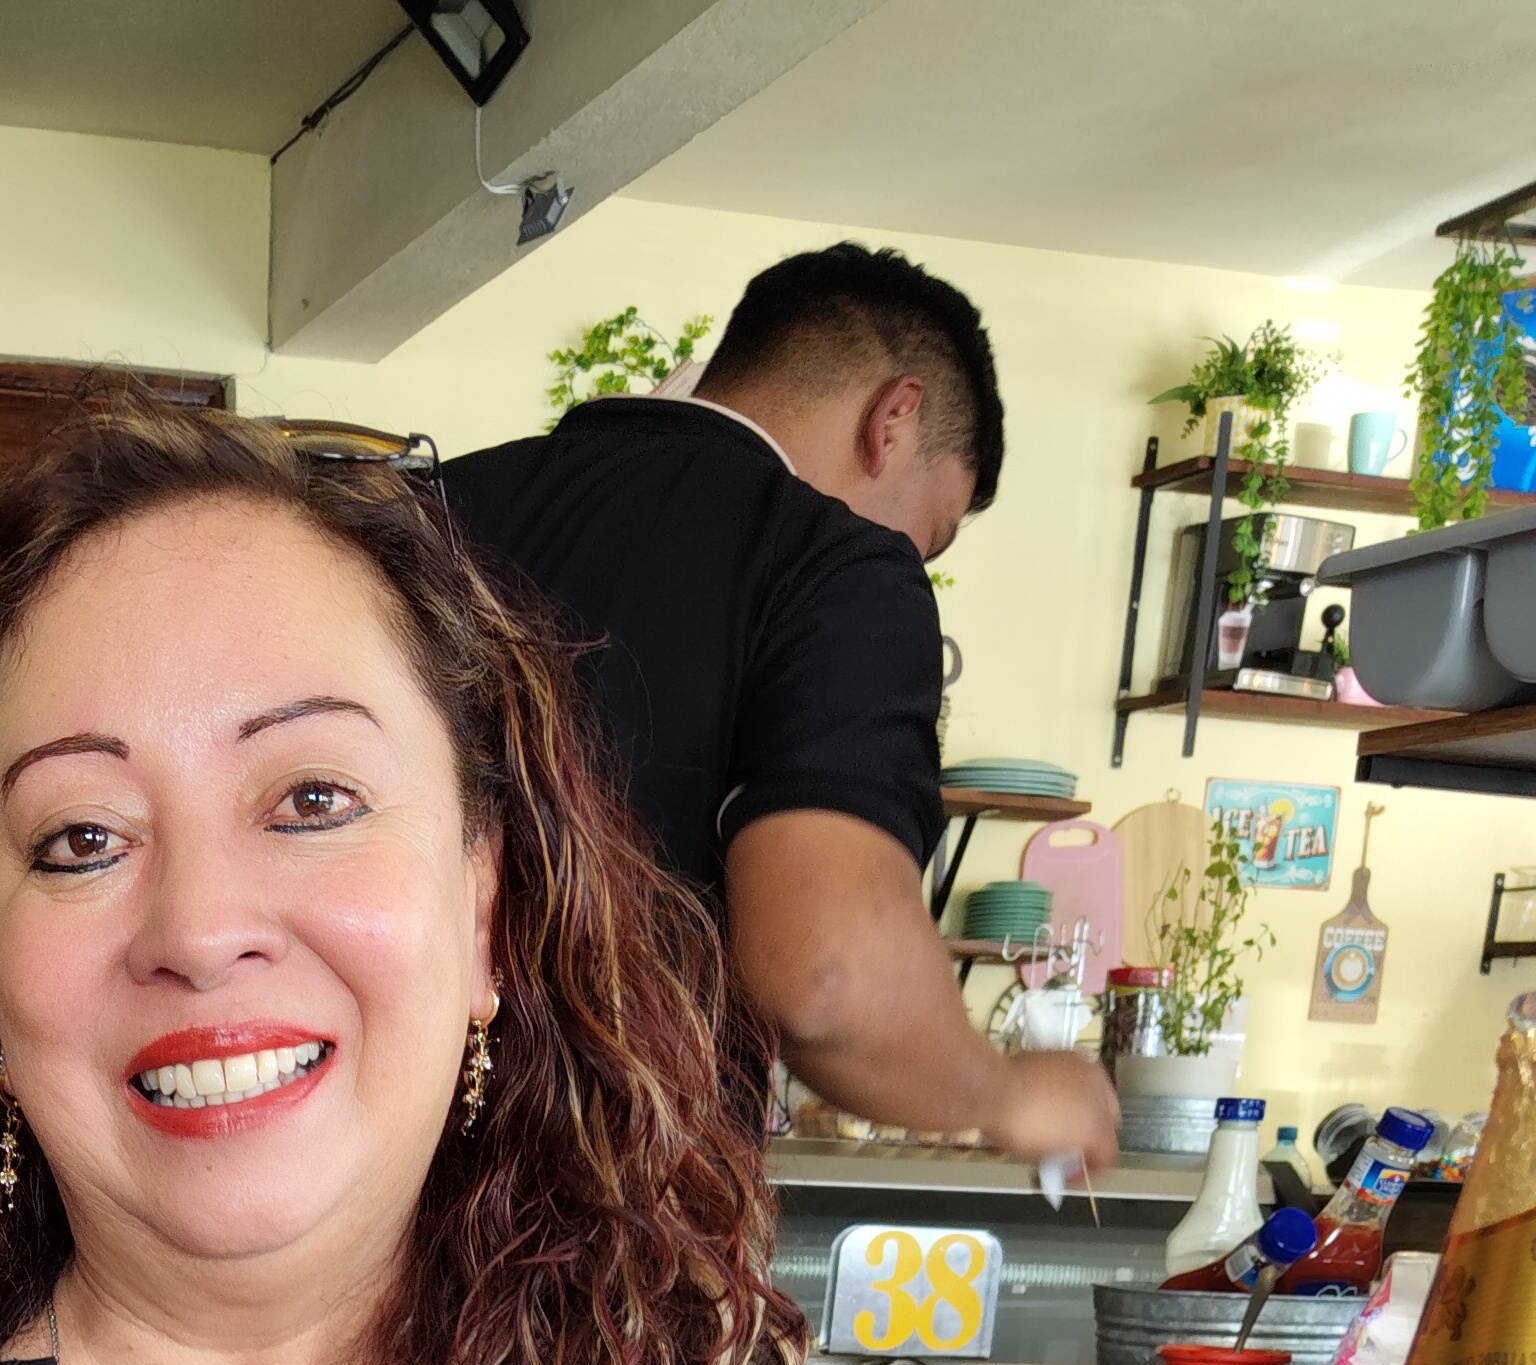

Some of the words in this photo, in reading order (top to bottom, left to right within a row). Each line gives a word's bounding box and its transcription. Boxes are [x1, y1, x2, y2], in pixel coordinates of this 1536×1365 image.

[1212, 806, 1253, 840] ICE
[1284, 824, 1329, 861] TEA
[1323, 927, 1386, 951] COFFEE
[854, 1230, 986, 1351] 38
